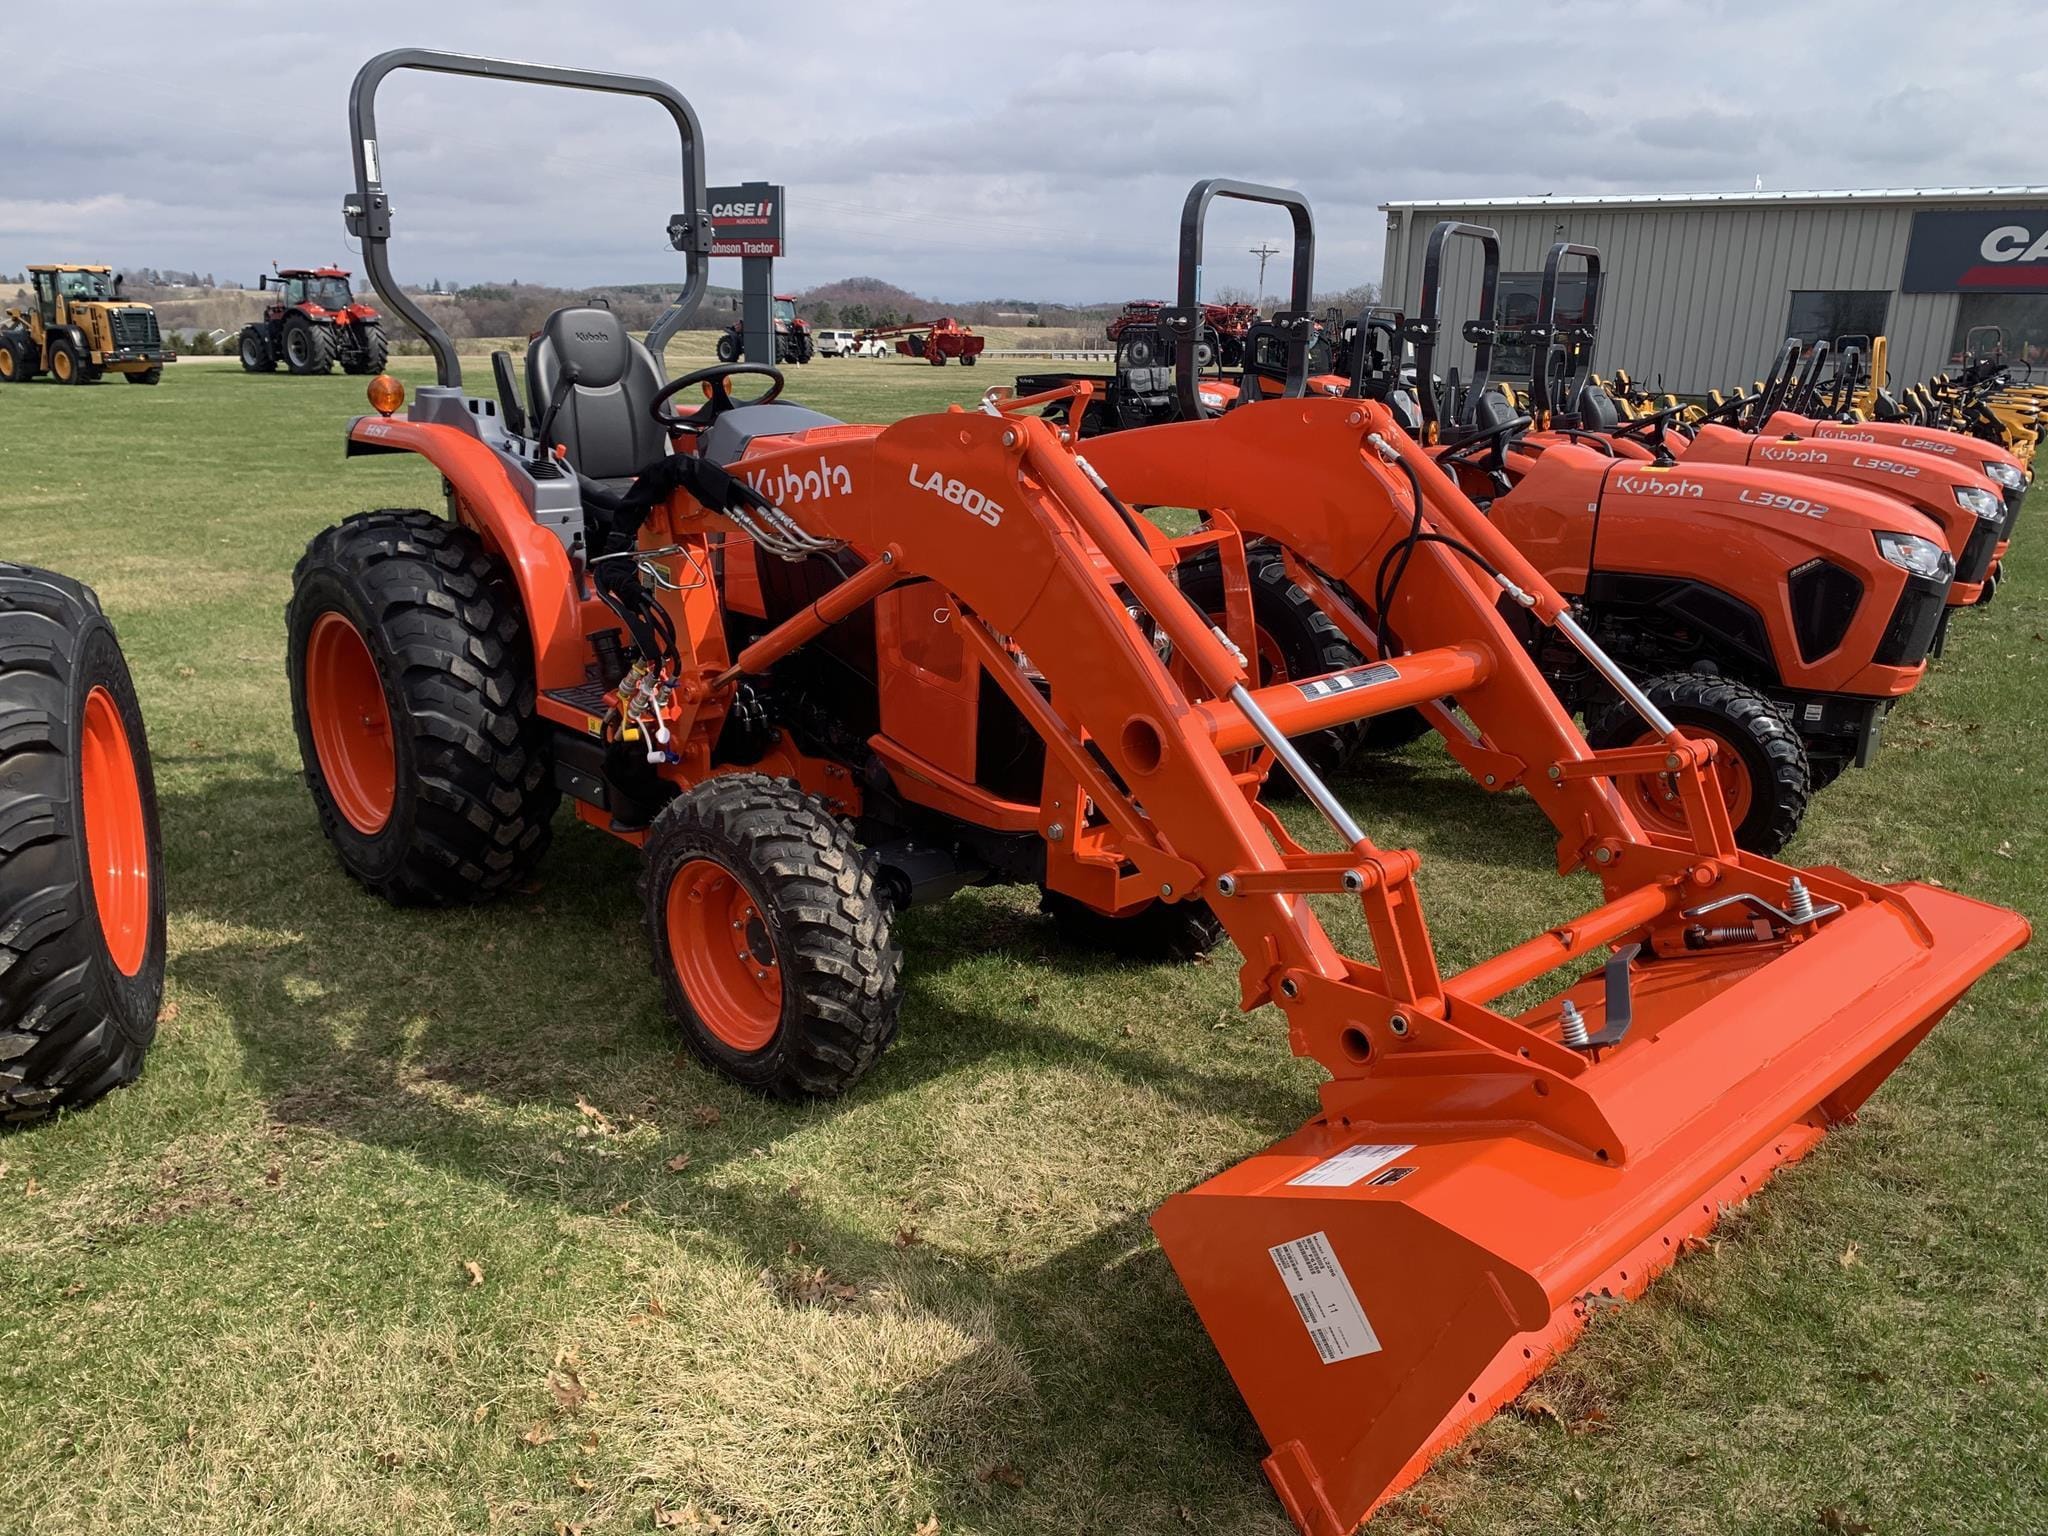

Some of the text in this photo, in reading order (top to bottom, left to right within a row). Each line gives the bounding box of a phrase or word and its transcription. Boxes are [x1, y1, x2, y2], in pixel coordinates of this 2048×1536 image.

[711, 203, 756, 218] CASE
[736, 217, 769, 225] AGRICULTURE
[709, 241, 774, 254] ohnson Tractor
[1760, 446, 1829, 464] Kubota
[1901, 438, 1957, 455] L2502
[1852, 456, 1921, 478] L3902
[747, 456, 853, 506] Kubota
[1616, 475, 1704, 498] Kubota
[908, 463, 1005, 527] LA805
[1739, 489, 1829, 519] L3902
